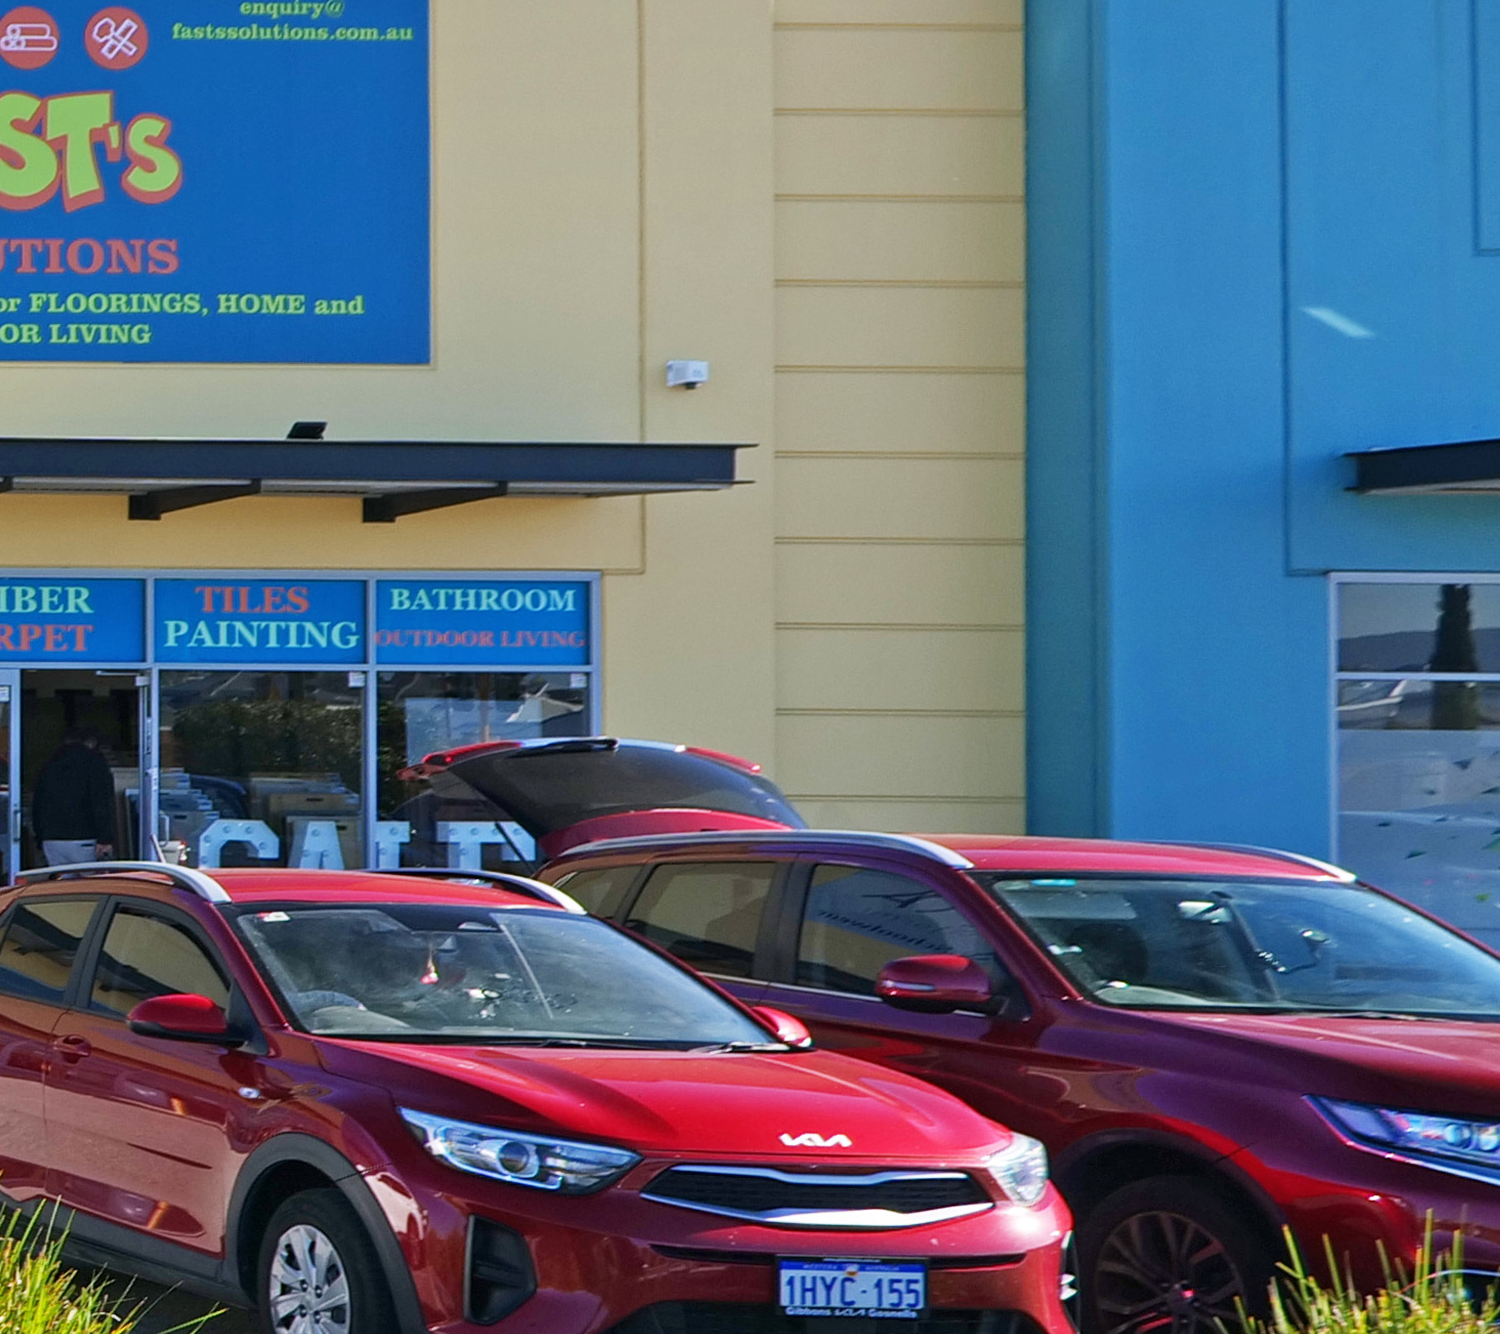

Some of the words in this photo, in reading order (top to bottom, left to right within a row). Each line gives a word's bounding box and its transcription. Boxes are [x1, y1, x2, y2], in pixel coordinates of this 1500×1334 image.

[172, 23, 413, 41] fastssolutions.com.au
[29, 293, 210, 317] FLOORINGS,
[217, 294, 306, 315] HOME
[315, 295, 365, 315] and
[49, 324, 152, 345] LIVING
[194, 586, 311, 614] TILES
[390, 589, 577, 612] BATHROOM
[164, 620, 360, 649] PAINTING
[375, 630, 496, 648] OUTDOOR
[502, 630, 587, 649] LIVING
